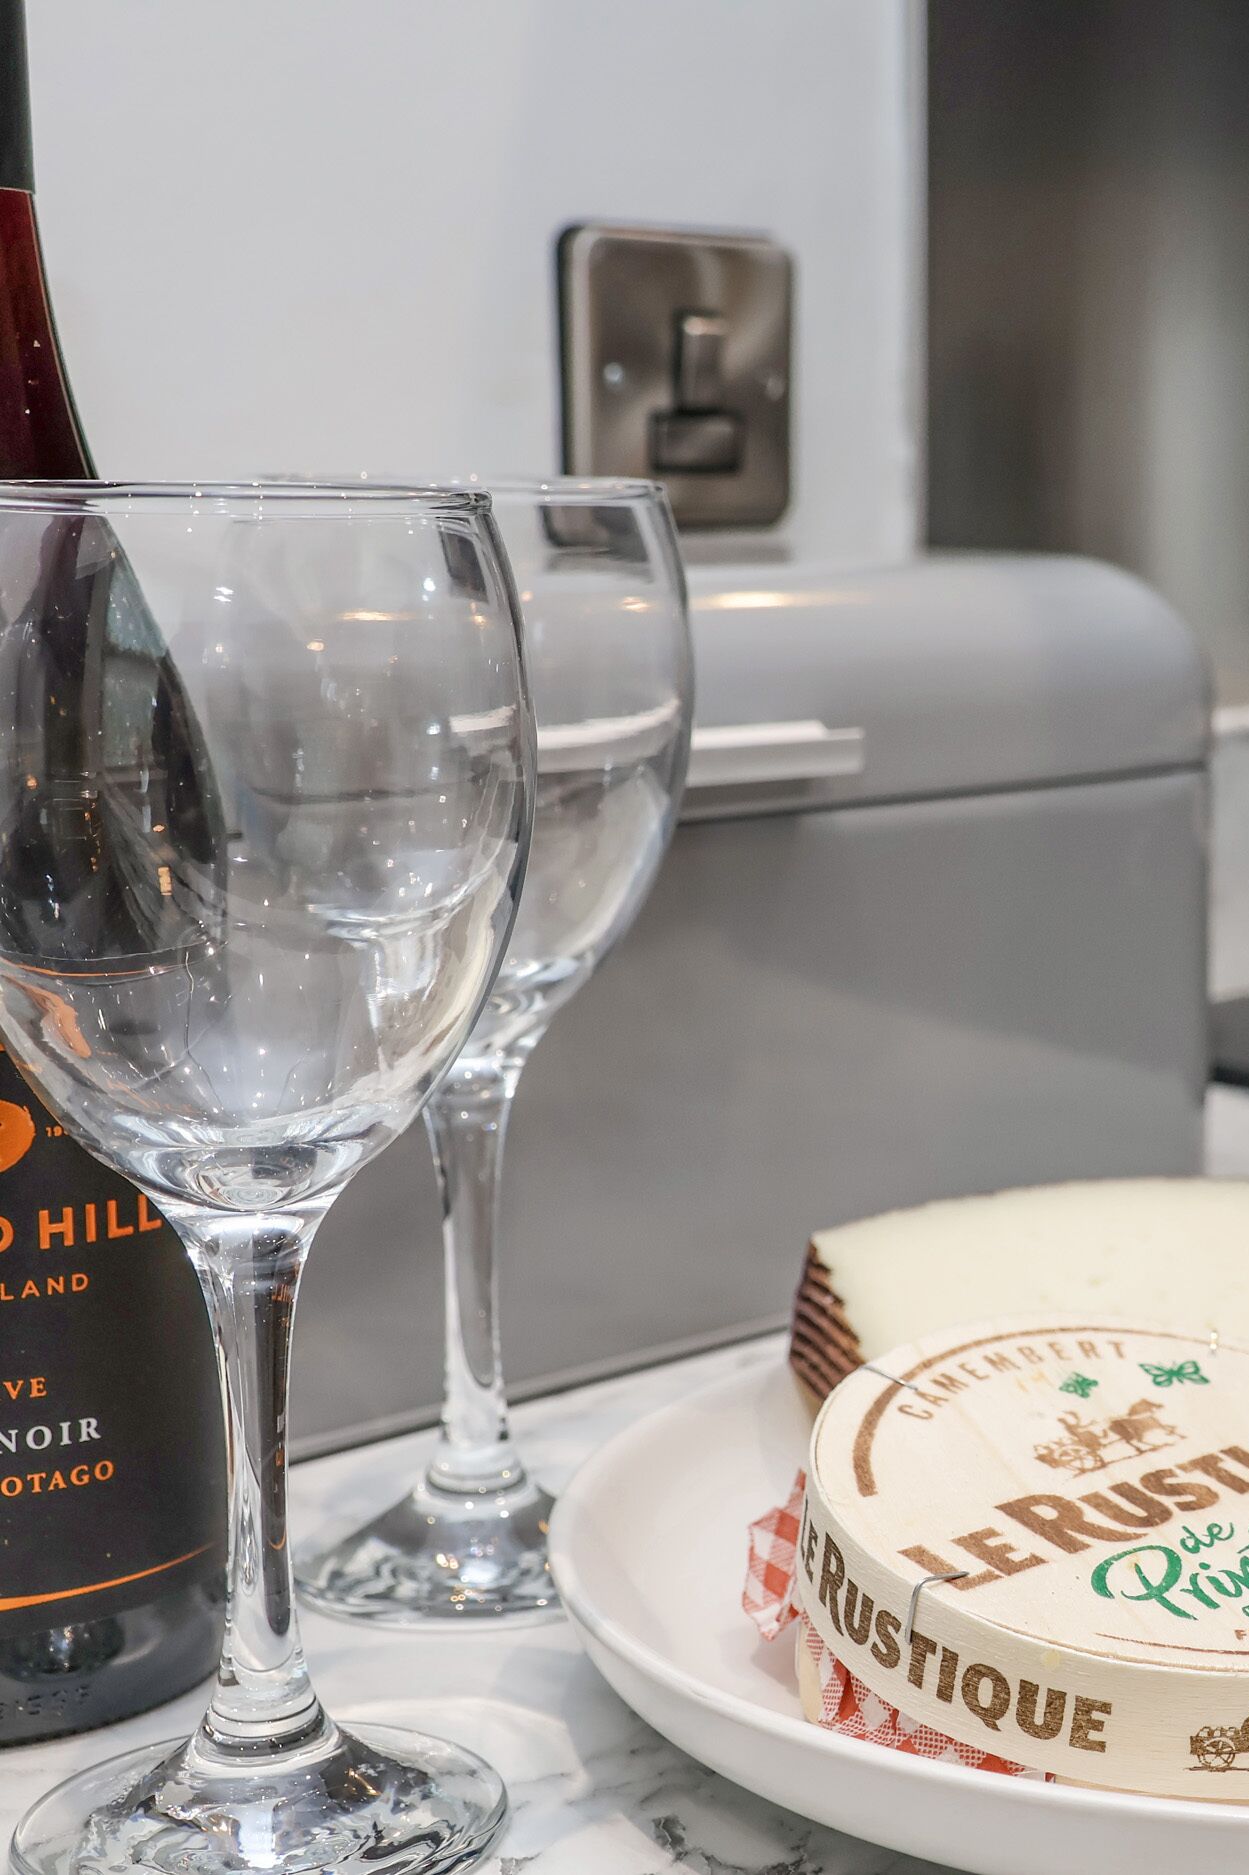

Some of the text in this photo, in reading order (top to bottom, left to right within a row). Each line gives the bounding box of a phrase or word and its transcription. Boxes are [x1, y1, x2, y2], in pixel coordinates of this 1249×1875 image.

[38, 1193, 163, 1251] HILL
[896, 1340, 1126, 1421] CAMEMBERT
[0, 1460, 115, 1498] OTAGO
[897, 1526, 1050, 1592] LE
[1180, 1522, 1235, 1554] de
[818, 1531, 1113, 1754] RUSTIQUE
